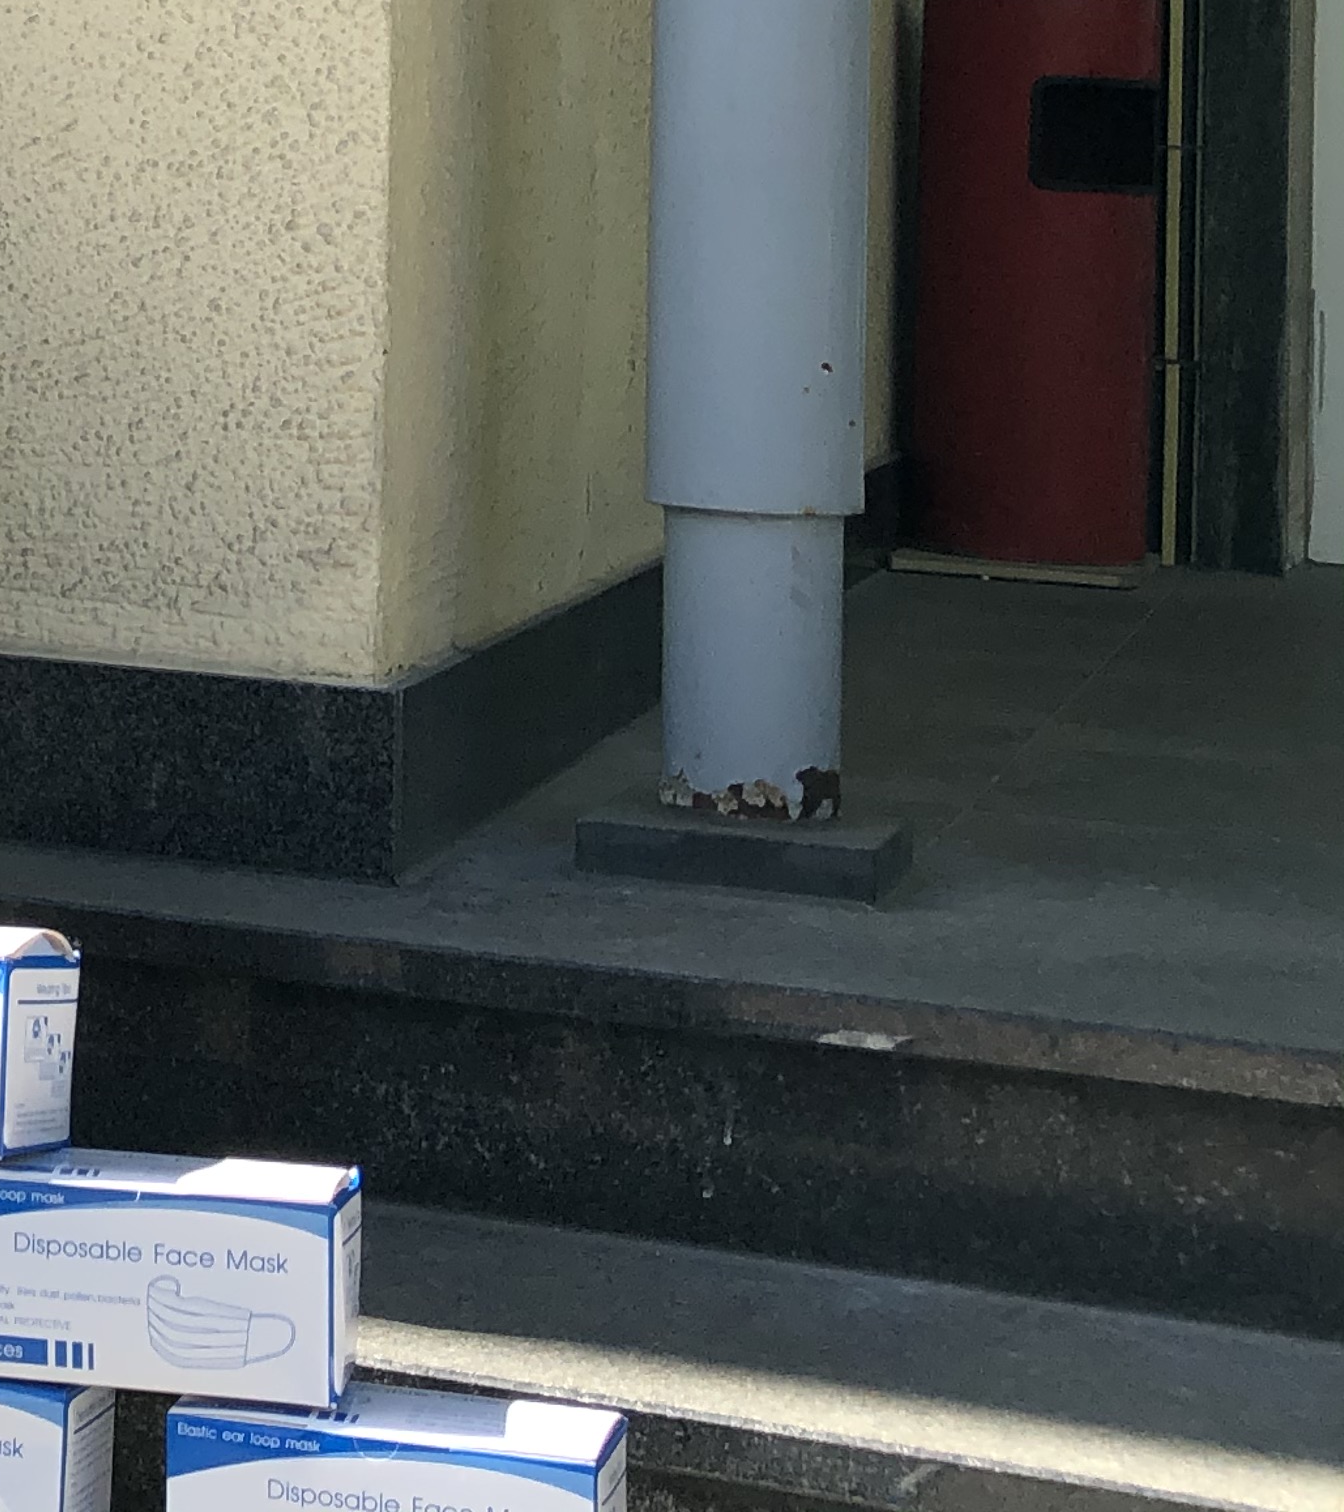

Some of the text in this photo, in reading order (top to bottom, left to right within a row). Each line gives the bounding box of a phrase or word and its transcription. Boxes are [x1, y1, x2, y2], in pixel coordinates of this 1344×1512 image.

[30, 1191, 65, 1205] mask
[13, 1231, 289, 1275] Disposable Face Mask
[221, 1430, 246, 1444] ear
[250, 1431, 280, 1451] loop
[285, 1439, 321, 1453] mask
[267, 1477, 399, 1512] Disposable
